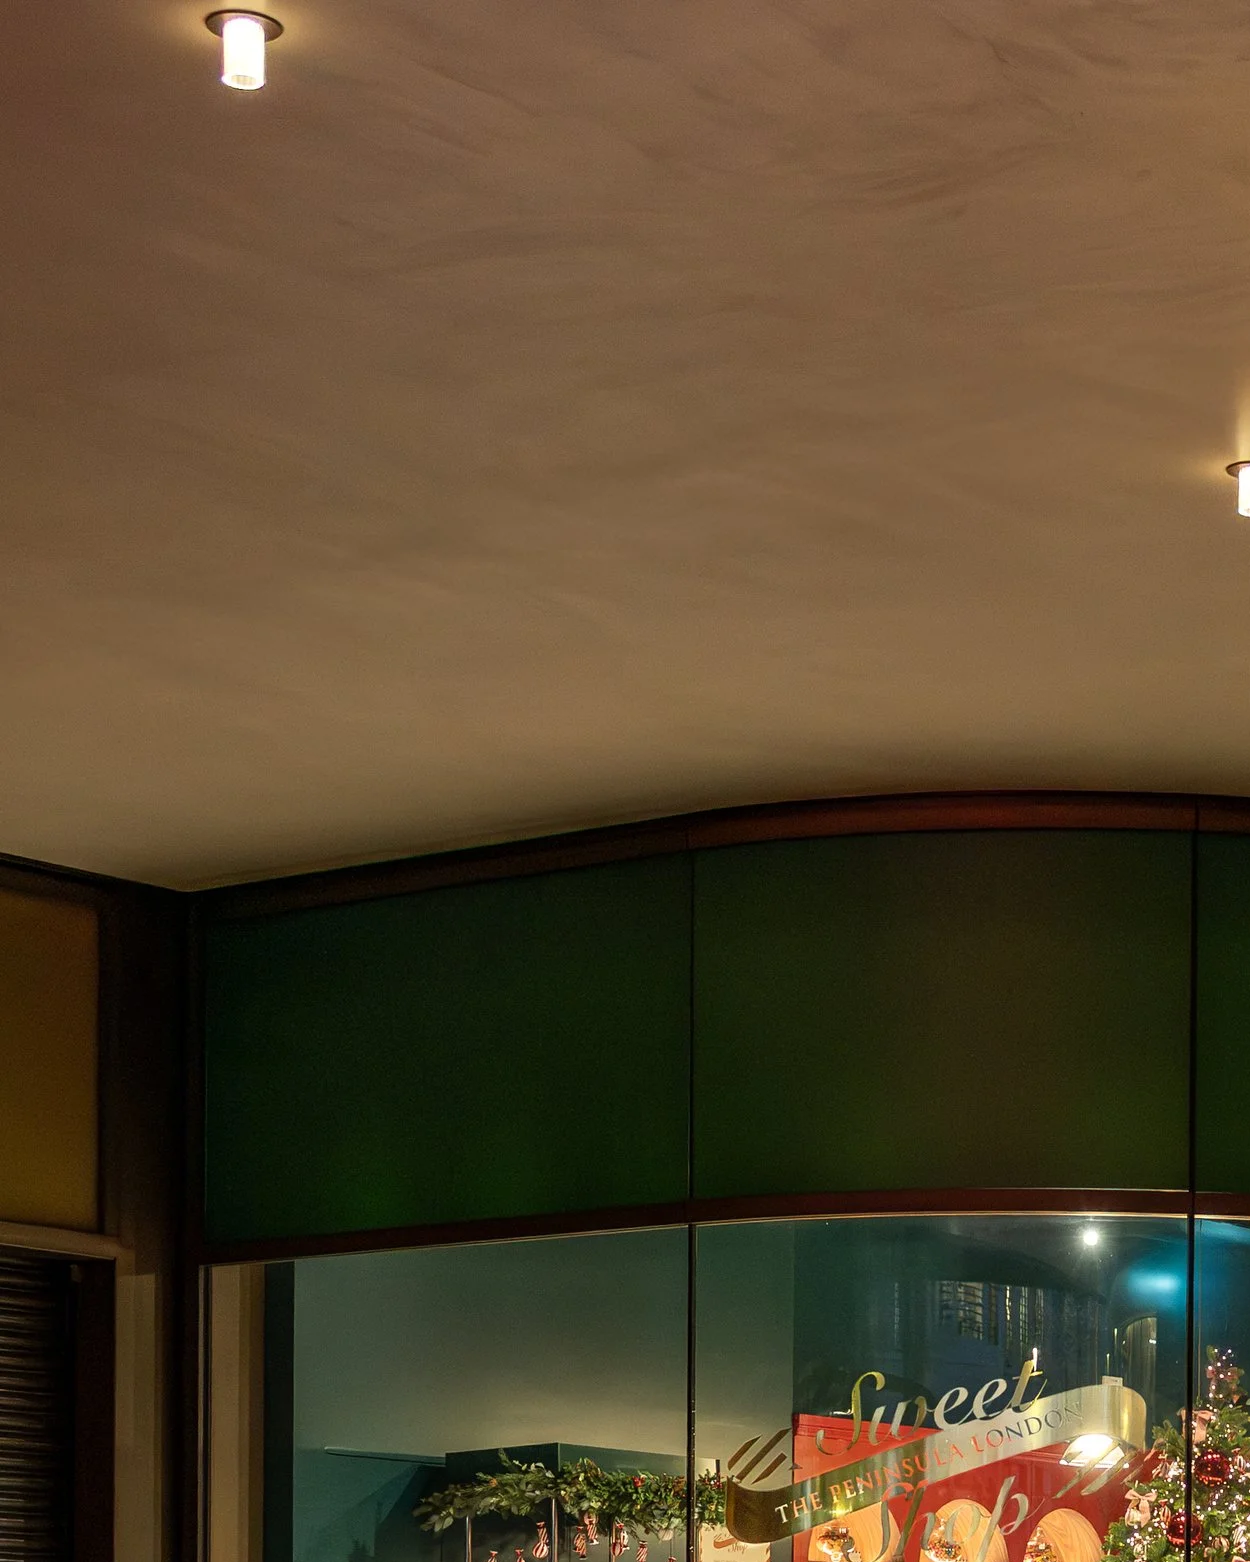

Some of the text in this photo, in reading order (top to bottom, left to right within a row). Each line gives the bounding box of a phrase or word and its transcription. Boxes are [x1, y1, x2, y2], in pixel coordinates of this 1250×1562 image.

[817, 1359, 1047, 1455] Sweet
[774, 1401, 1084, 1525] THE PENINSULA LONDON
